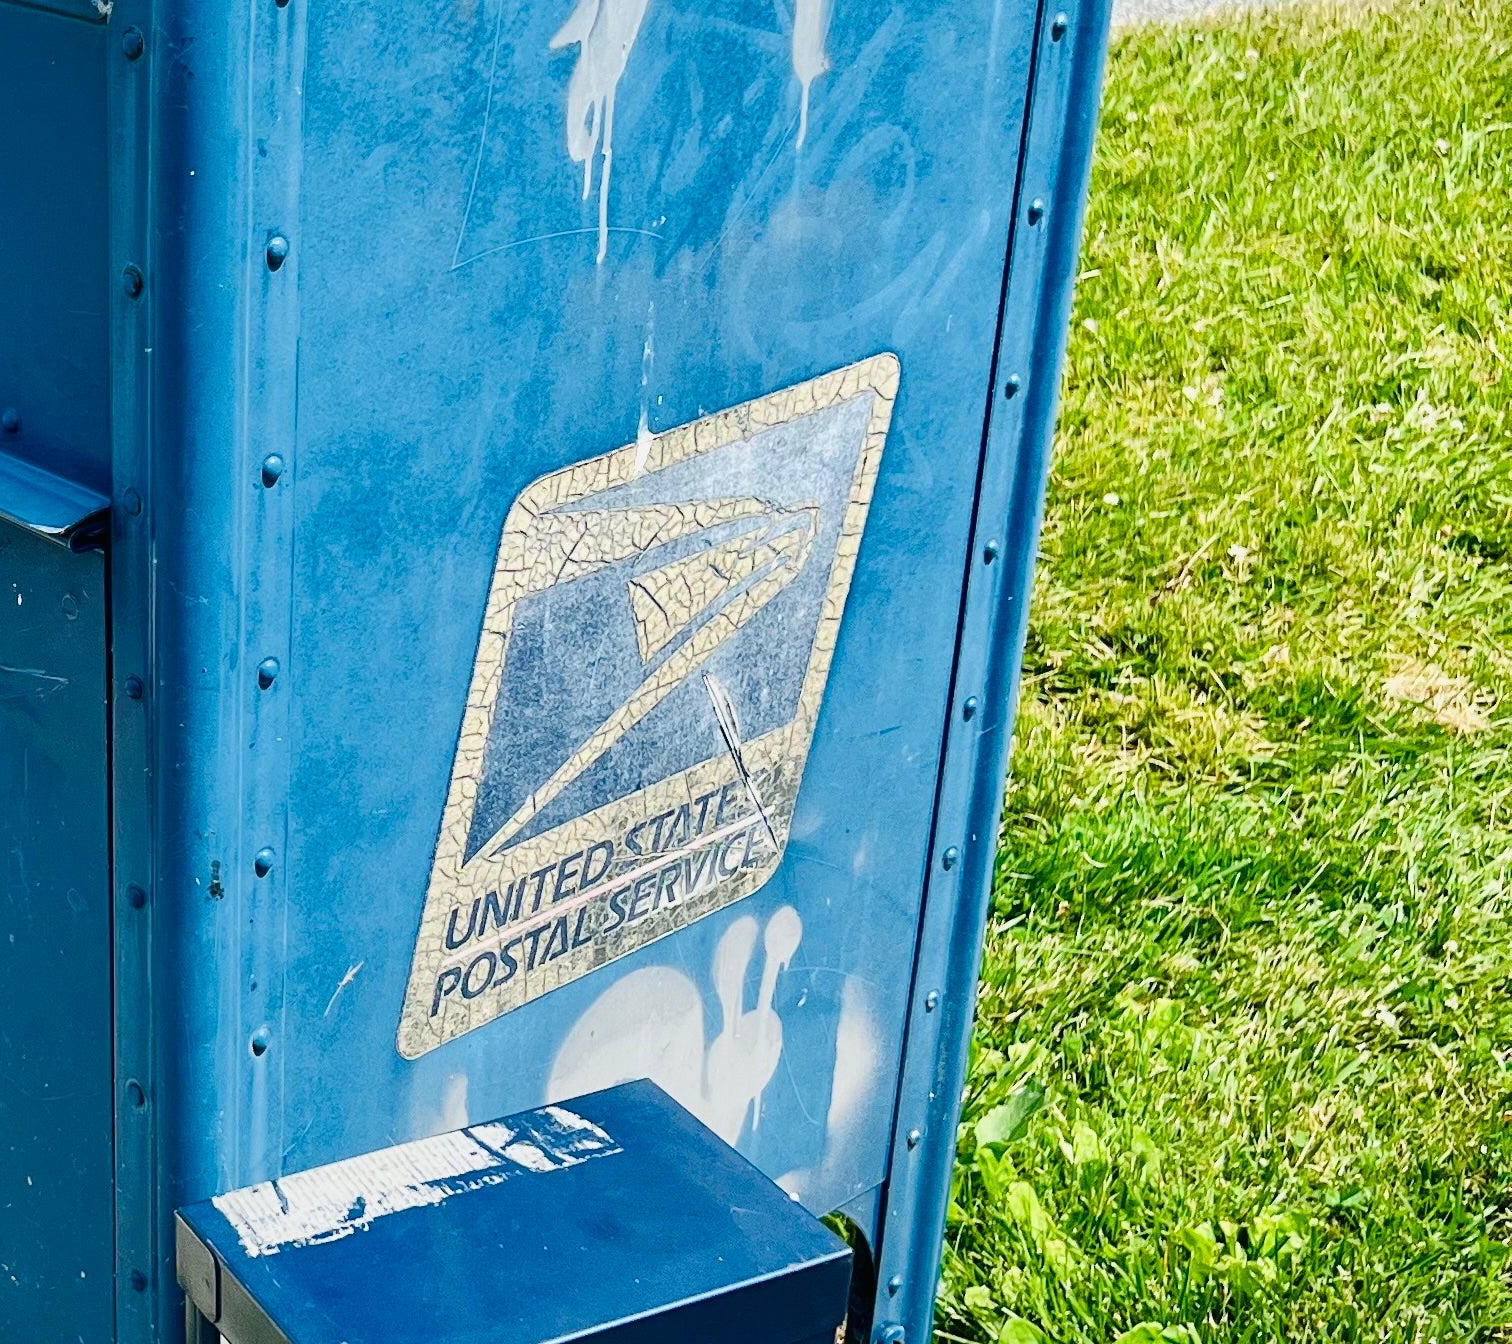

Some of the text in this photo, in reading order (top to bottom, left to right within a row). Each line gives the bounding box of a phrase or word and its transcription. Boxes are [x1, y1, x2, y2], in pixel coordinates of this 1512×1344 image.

[430, 829, 768, 1018] POSTAL SERVICE
[445, 768, 768, 950] UNITED STATE
